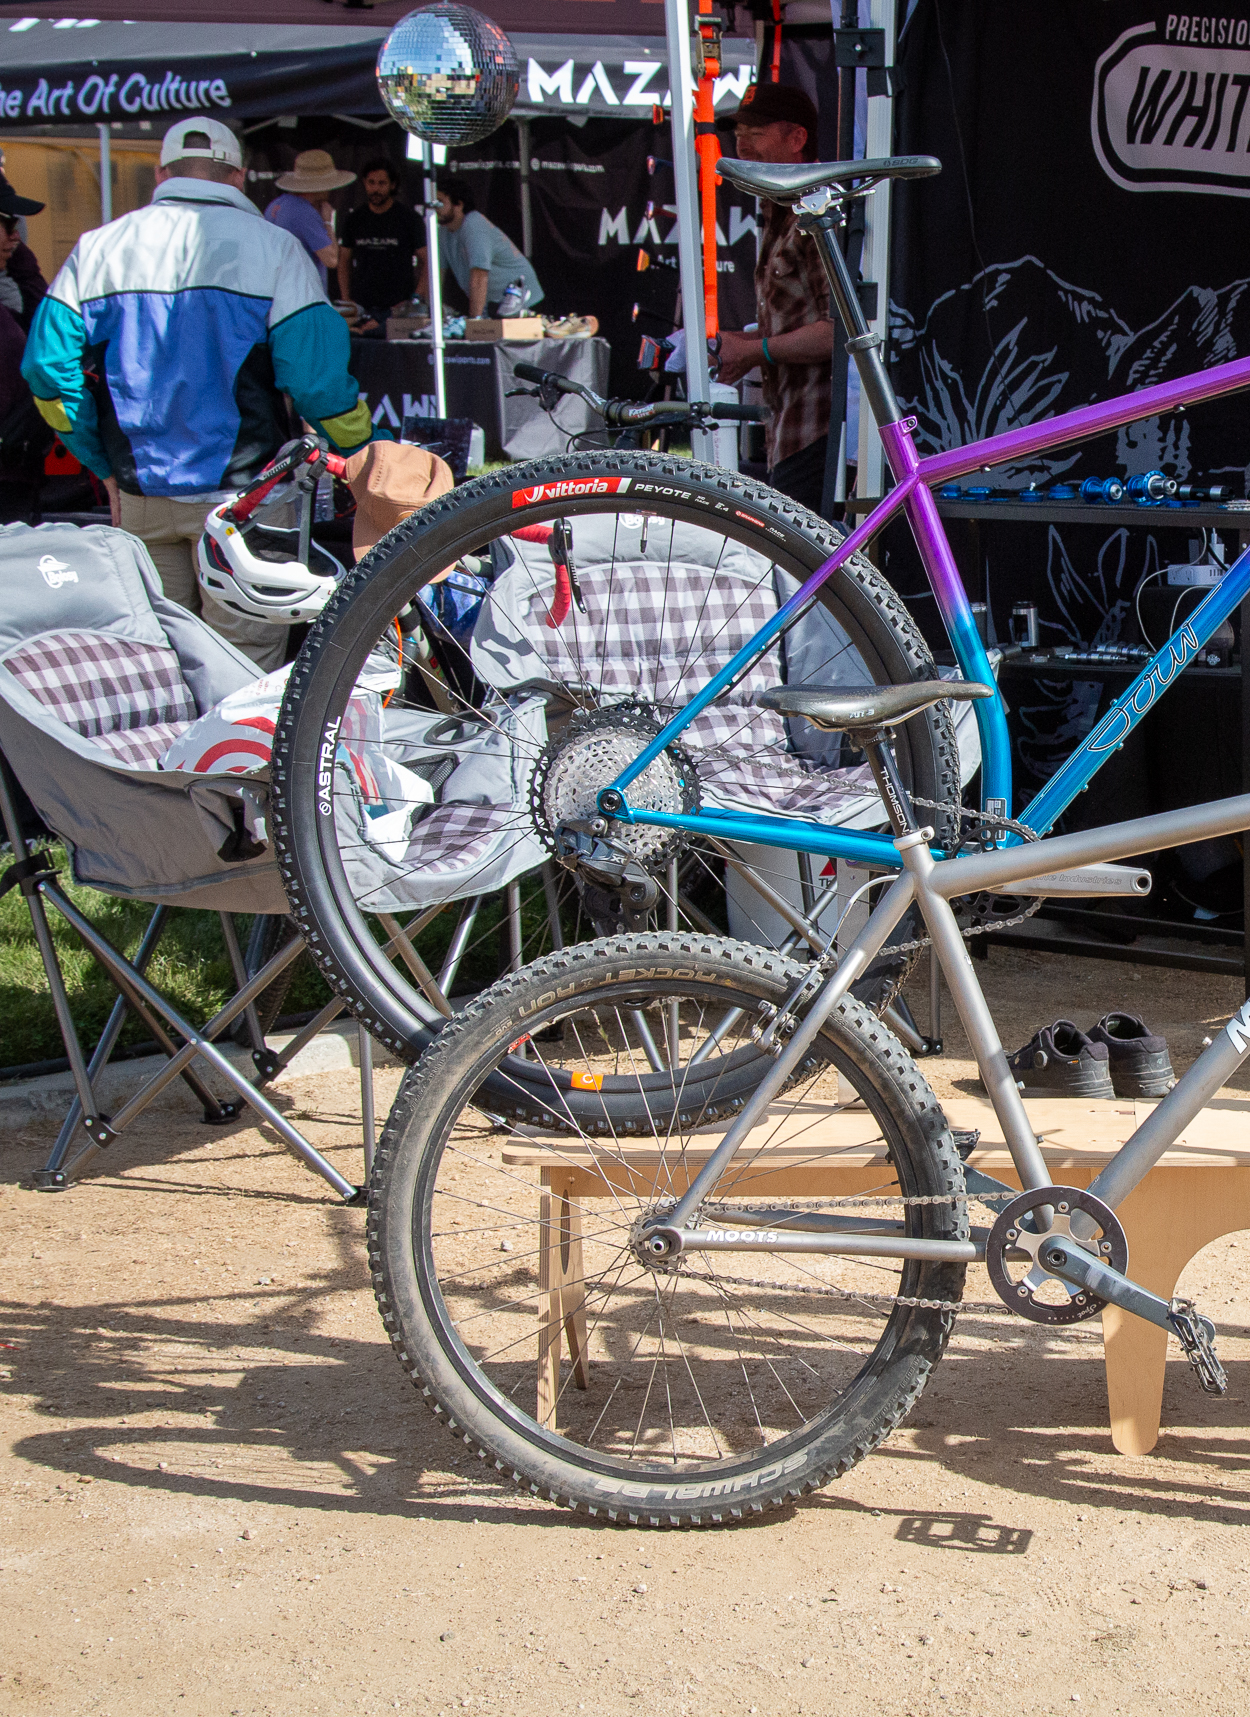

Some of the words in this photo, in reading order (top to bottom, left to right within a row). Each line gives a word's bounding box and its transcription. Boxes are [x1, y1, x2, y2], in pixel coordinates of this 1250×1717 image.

[27, 77, 75, 117] Art
[77, 73, 119, 115] Of
[119, 70, 232, 114] Culture
[549, 480, 608, 499] vittoria
[634, 484, 691, 500] PEYOTE
[318, 716, 341, 802] ASTRAL
[880, 766, 910, 833] THOMSON
[1059, 873, 1123, 886] Industries
[603, 966, 717, 984] ROCKET
[705, 1230, 778, 1244] MOOTS
[1077, 1303, 1097, 1319] Spot
[594, 1449, 808, 1500] SCHWALBE
